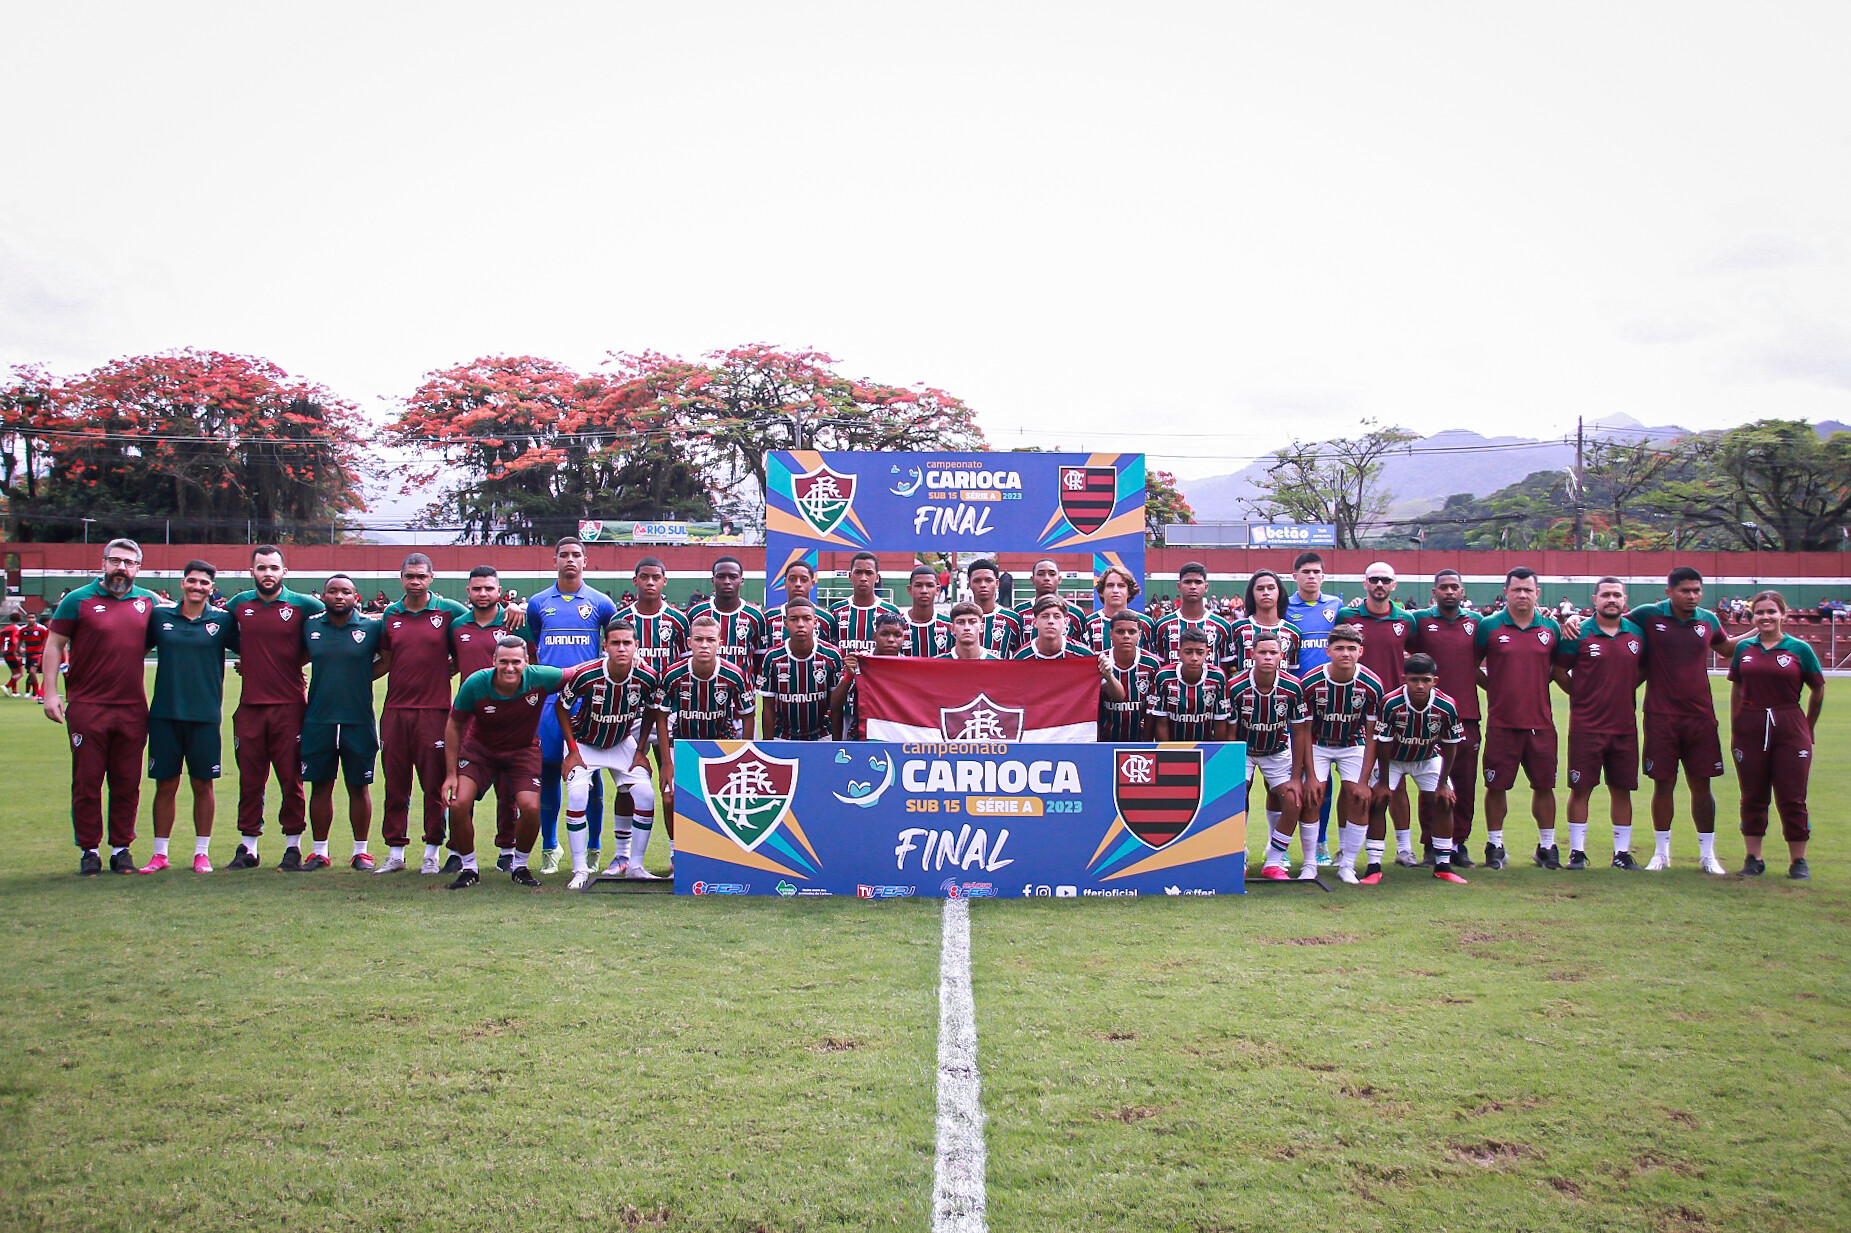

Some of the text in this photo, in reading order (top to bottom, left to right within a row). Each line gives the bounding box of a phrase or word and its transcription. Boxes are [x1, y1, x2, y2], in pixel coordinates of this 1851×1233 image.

[926, 461, 983, 470] campeonato
[926, 470, 1022, 490] CARIOCA
[928, 490, 1022, 500] SUB 15 SÉRIE A 2023
[914, 502, 995, 536] FINAL
[647, 525, 688, 535] RIO SUL
[902, 743, 1008, 758] campeonato
[901, 759, 1082, 794] CARIOCA
[905, 798, 1083, 813] SUB 15 SÉRIE A 2023
[894, 823, 1015, 872] FINAL
